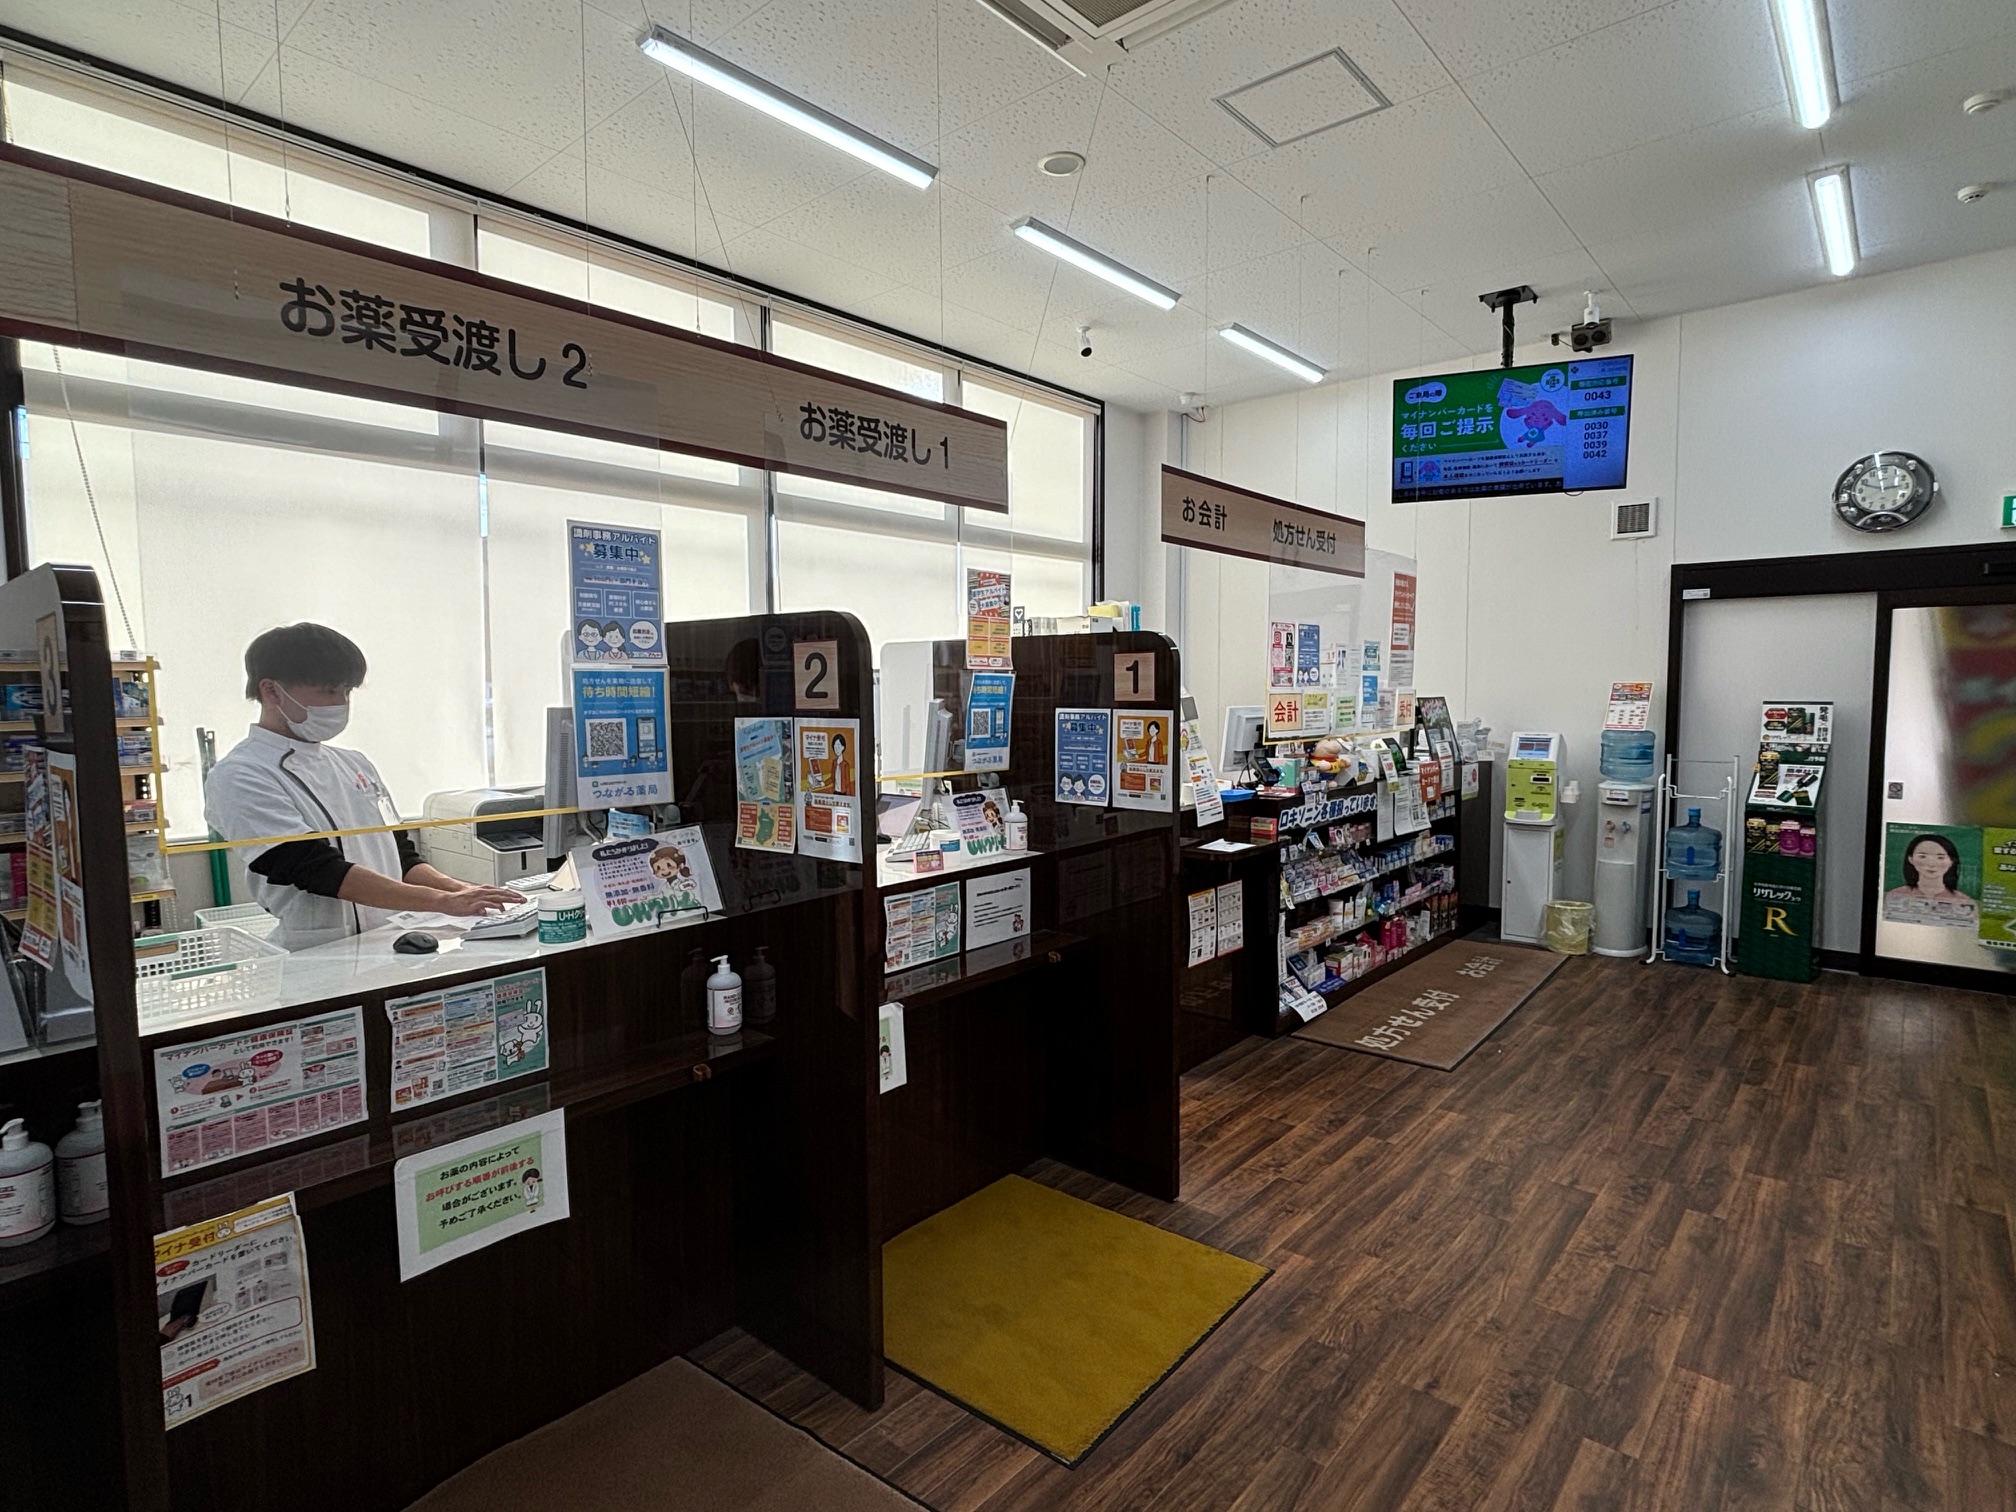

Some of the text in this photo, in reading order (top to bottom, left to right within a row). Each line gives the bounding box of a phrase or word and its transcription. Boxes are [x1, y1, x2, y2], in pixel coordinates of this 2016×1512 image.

[1584, 390, 1612, 401] 0043
[1401, 403, 1494, 420] マイナンバーカードを
[1400, 416, 1495, 441] 毎回ご提示
[1584, 421, 1609, 431] 0030
[1584, 430, 1608, 441] 0037
[1402, 442, 1437, 453] ください
[1583, 440, 1608, 450] 0039
[1583, 449, 1607, 460] 0042
[1182, 496, 1228, 532] お会計
[572, 527, 657, 546] 調剤事務アルバイト
[1272, 518, 1337, 555] 処方せん受付
[592, 542, 639, 562] 募集中
[804, 652, 829, 699] 2
[1125, 659, 1140, 695] 1
[1273, 699, 1299, 723] 会計
[592, 784, 658, 799] つながる薬局
[1763, 906, 1800, 937] R
[1456, 956, 1504, 978] お会計
[1354, 989, 1460, 1051] 処方せん受付
[439, 1145, 520, 1181] お薬の内容によって
[425, 1156, 535, 1203] お呼びする順番が前後する
[441, 1178, 518, 1212] 場合がございます。
[438, 1193, 522, 1230] 予めご了承ください。
